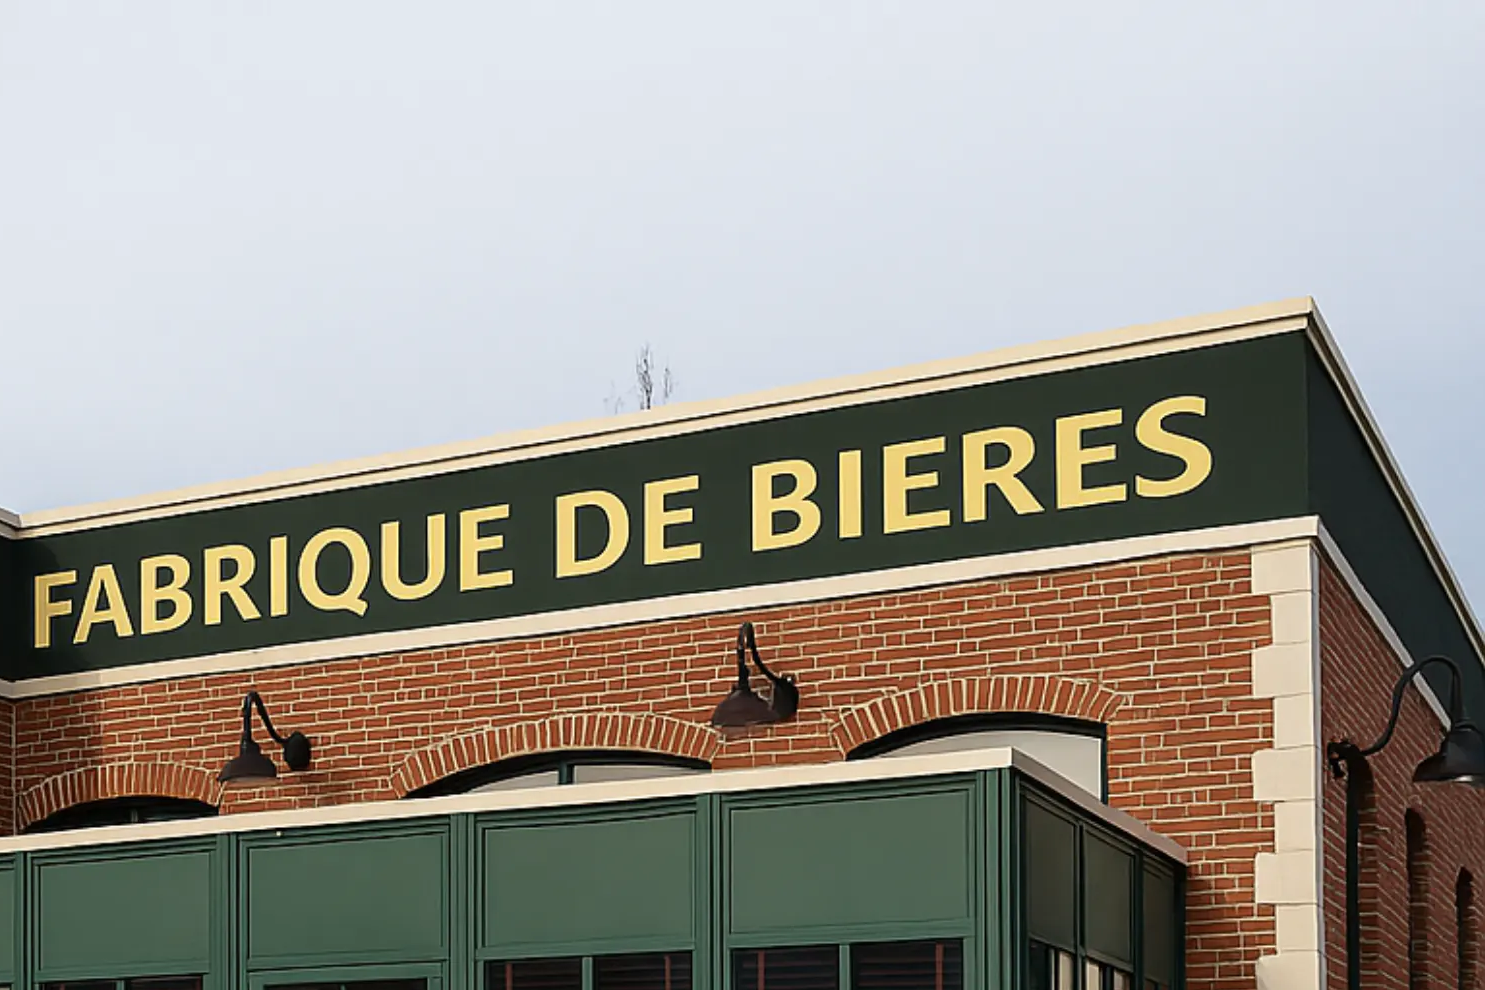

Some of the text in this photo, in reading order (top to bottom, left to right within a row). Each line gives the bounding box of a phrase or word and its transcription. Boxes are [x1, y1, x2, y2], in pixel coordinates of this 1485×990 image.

[34, 395, 1214, 649] FABRIQUE DE BIERES
